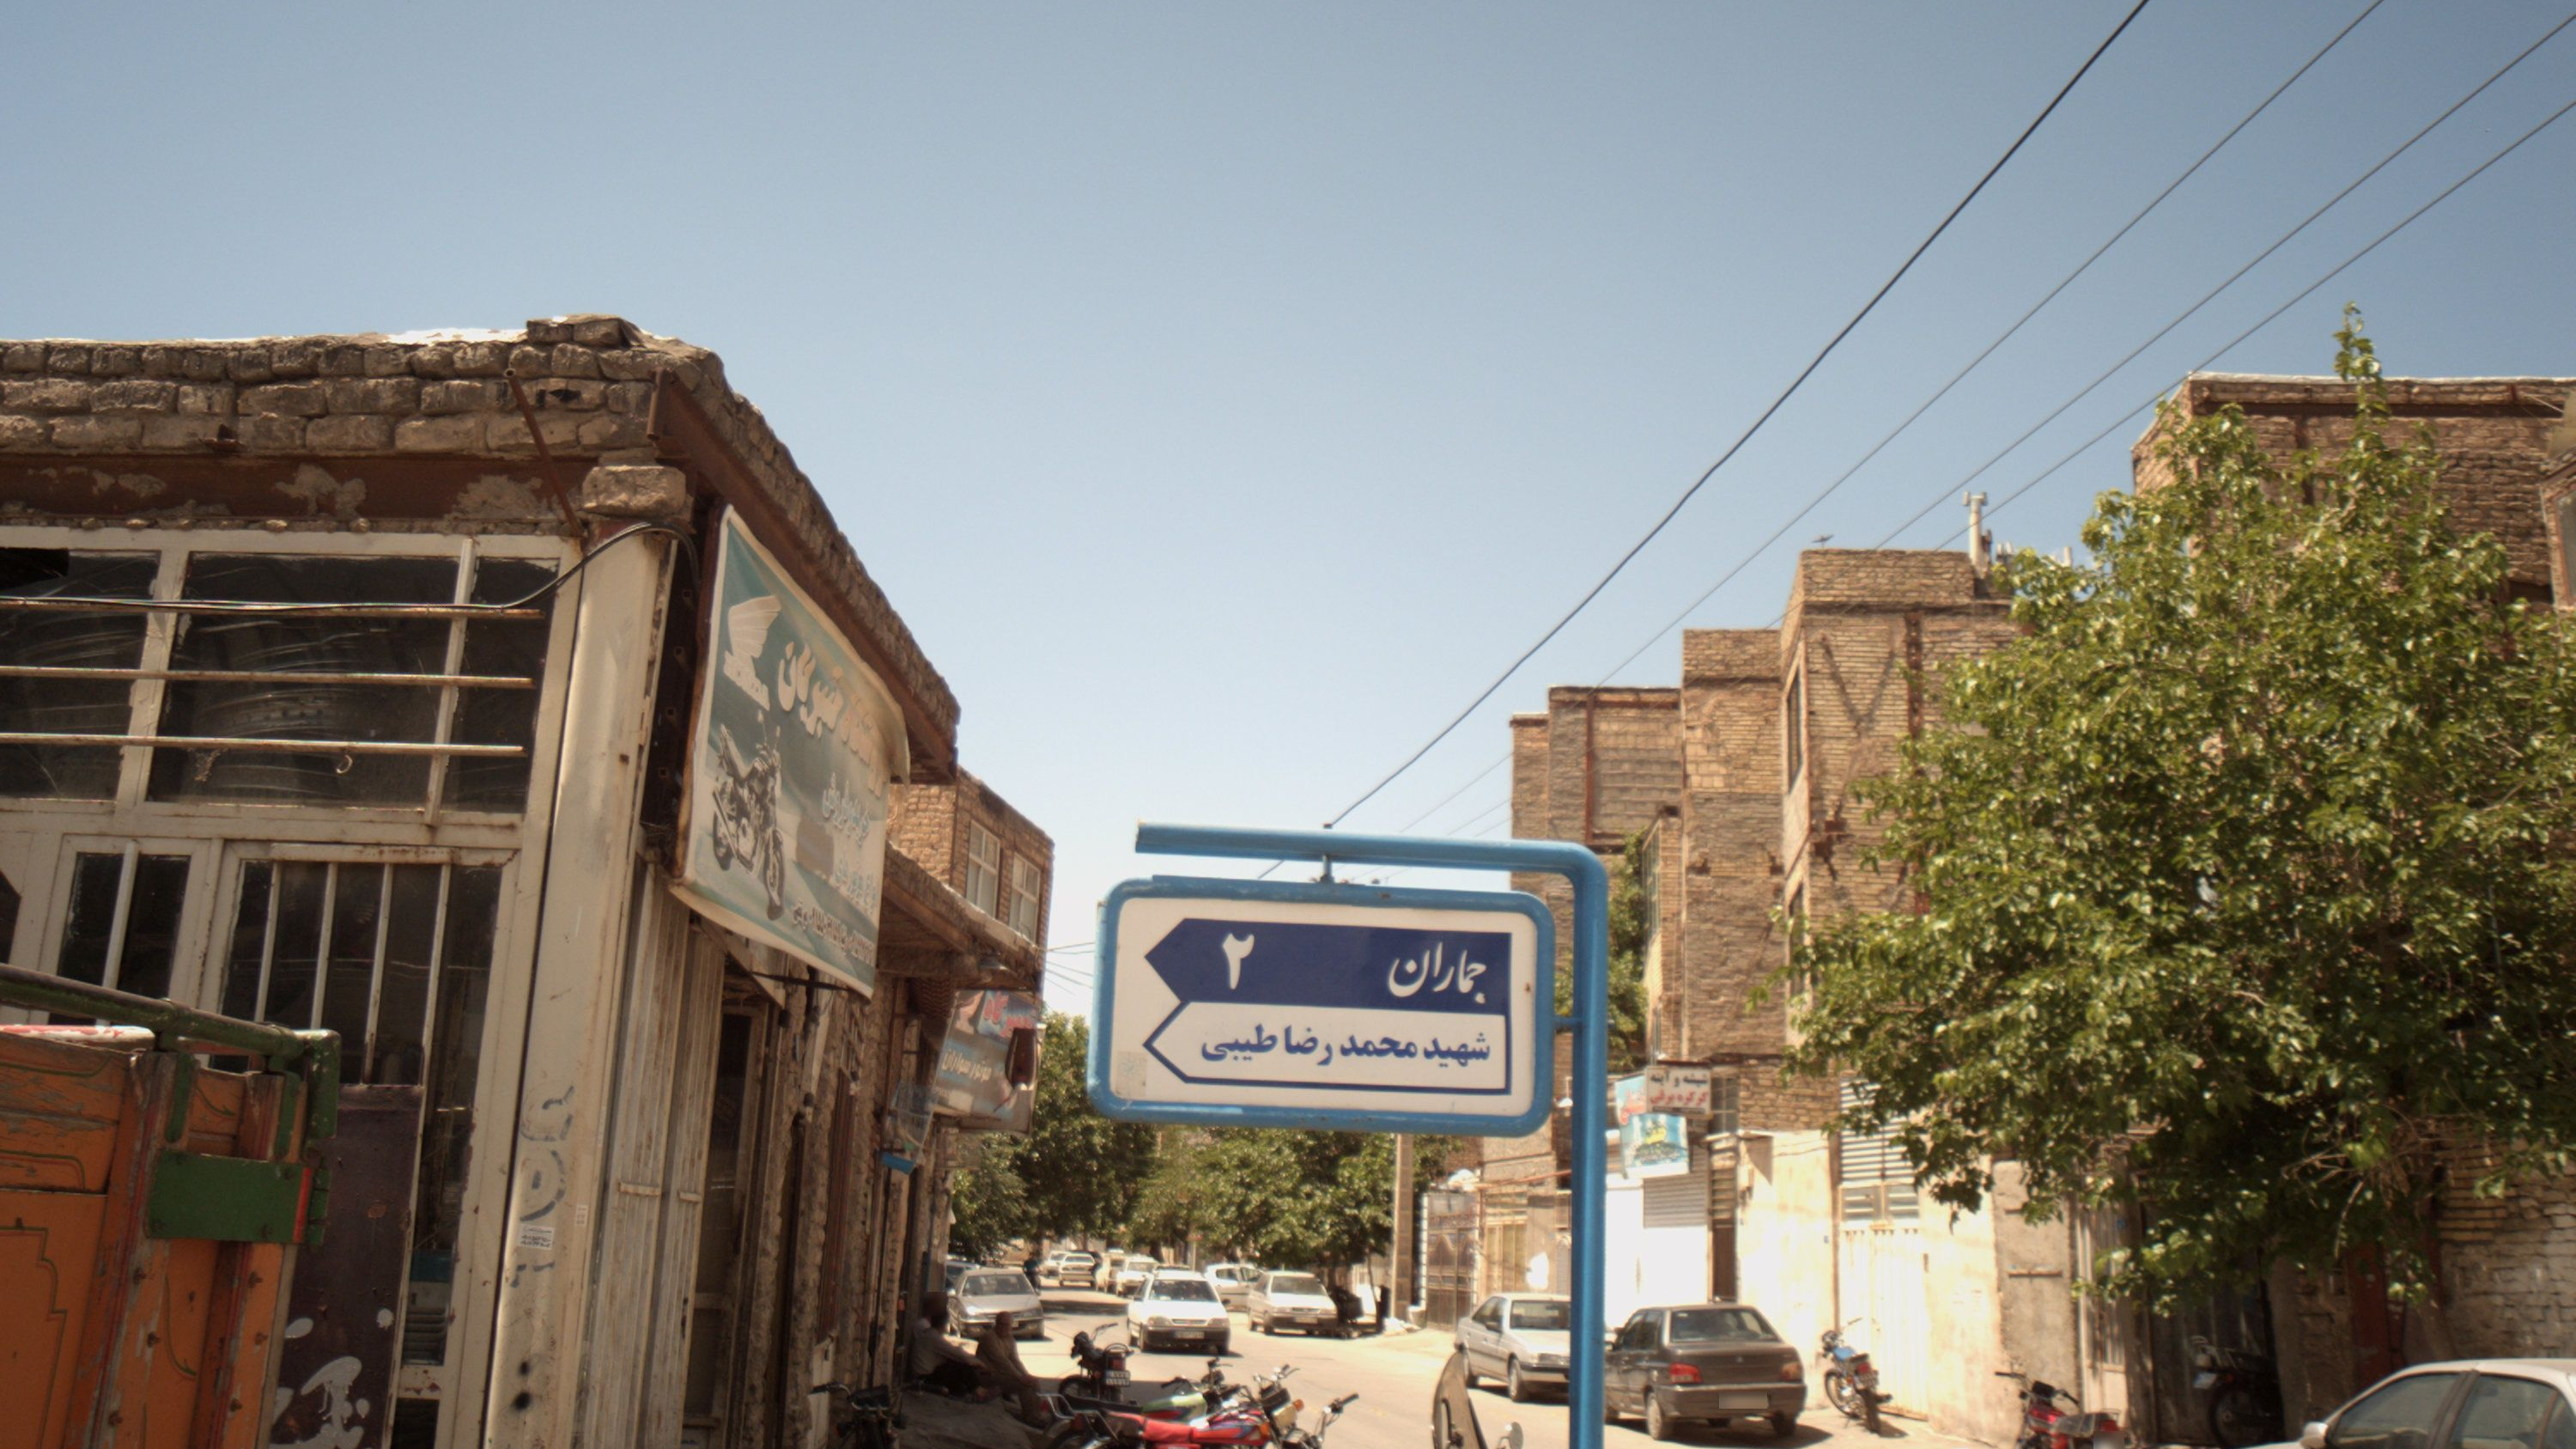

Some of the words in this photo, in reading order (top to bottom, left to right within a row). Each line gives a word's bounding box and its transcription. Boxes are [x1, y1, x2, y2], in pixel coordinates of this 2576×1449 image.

[1223, 933, 1255, 990] ۲
[1388, 942, 1487, 1005] جماران
[1201, 1023, 1279, 1062] طیبی
[1285, 1024, 1333, 1066] رضا
[1340, 1035, 1418, 1059] محمد
[1423, 1032, 1491, 1068] شهید
